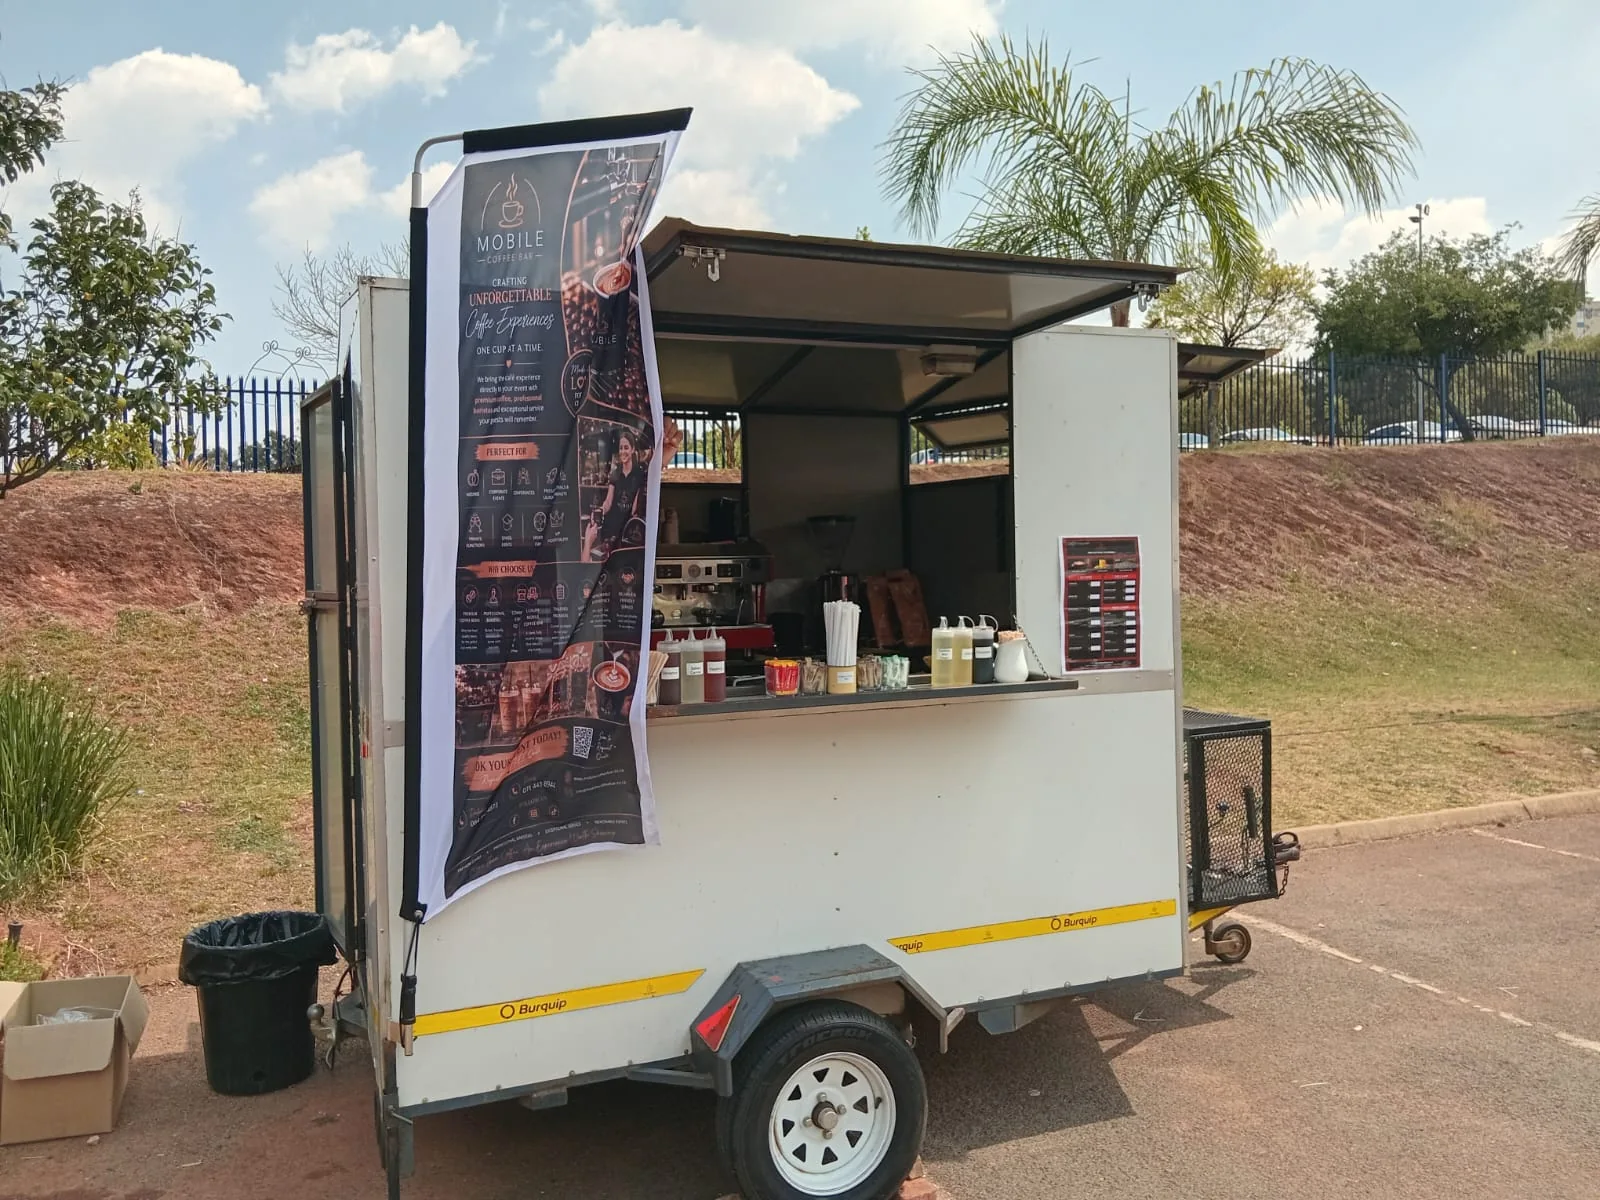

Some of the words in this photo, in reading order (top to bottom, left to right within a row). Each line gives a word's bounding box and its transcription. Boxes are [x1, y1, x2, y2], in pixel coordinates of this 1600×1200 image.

[477, 230, 544, 253] MOBILE
[487, 254, 517, 264] COFFEE
[492, 276, 528, 287] CRAFTING
[469, 288, 552, 307] UNFORGETTABLE
[465, 308, 494, 339] Coffee
[496, 306, 555, 339] Experiences
[476, 346, 490, 355] ONE
[492, 345, 507, 354] CUP
[507, 344, 515, 353] AT
[517, 344, 523, 352] A
[486, 448, 514, 457] PERFECT
[515, 447, 527, 456] FOR
[500, 564, 526, 573] CHOOSE
[532, 730, 562, 745] TODAY!
[1063, 916, 1097, 928] Burquip
[896, 940, 923, 953] rquip
[519, 998, 567, 1015] Burquip
